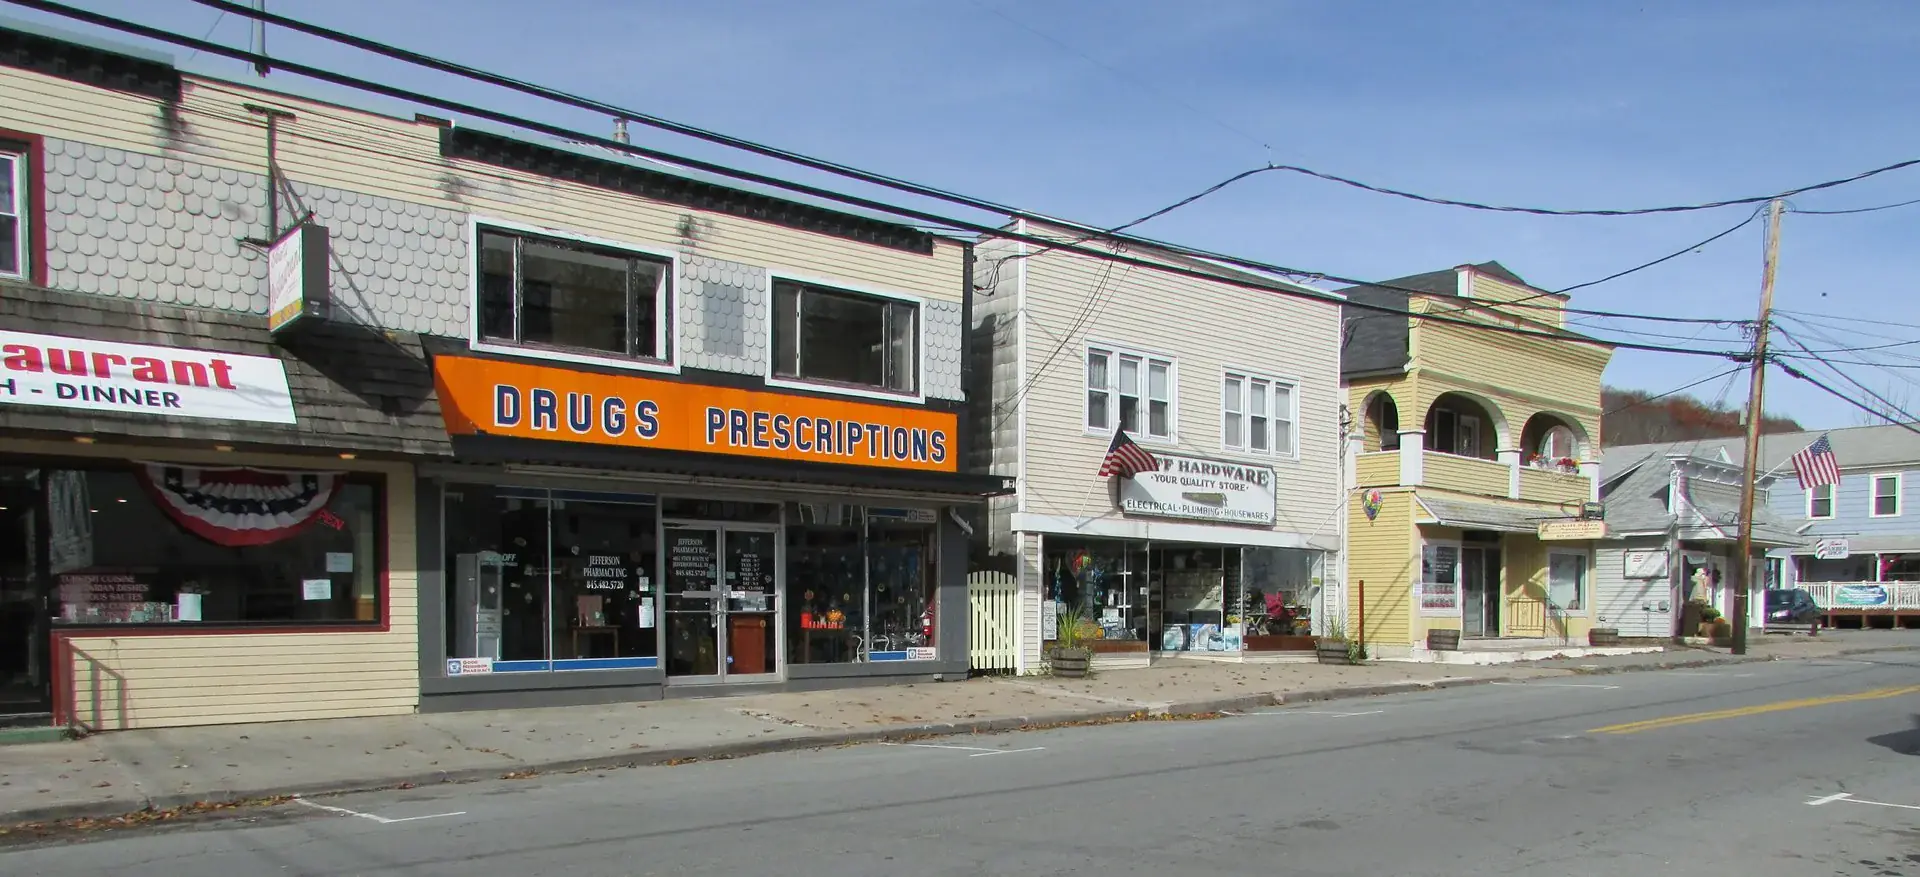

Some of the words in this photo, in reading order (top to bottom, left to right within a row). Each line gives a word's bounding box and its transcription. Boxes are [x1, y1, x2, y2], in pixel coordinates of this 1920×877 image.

[56, 382, 182, 409] DINNER
[493, 384, 660, 440] DRUGS
[705, 406, 946, 464] PRESCRIPTIONS
[1178, 460, 1270, 488] HARDWARE
[1154, 474, 1178, 485] YOUR
[1179, 477, 1216, 489] QUALITY
[1218, 481, 1246, 492] STORE
[1126, 499, 1179, 512] ELECTRICAL
[1182, 506, 1220, 517] PLUMBING
[1224, 510, 1269, 520] HOUSEWARES
[678, 538, 703, 546] JEFFERSON
[501, 553, 517, 562] OFF
[589, 555, 620, 566] JEFFERSON
[583, 567, 615, 577] PHARMACY
[100, 575, 135, 583] CUISINE
[115, 584, 150, 592] DISHES
[586, 580, 625, 590] 845.482.5720
